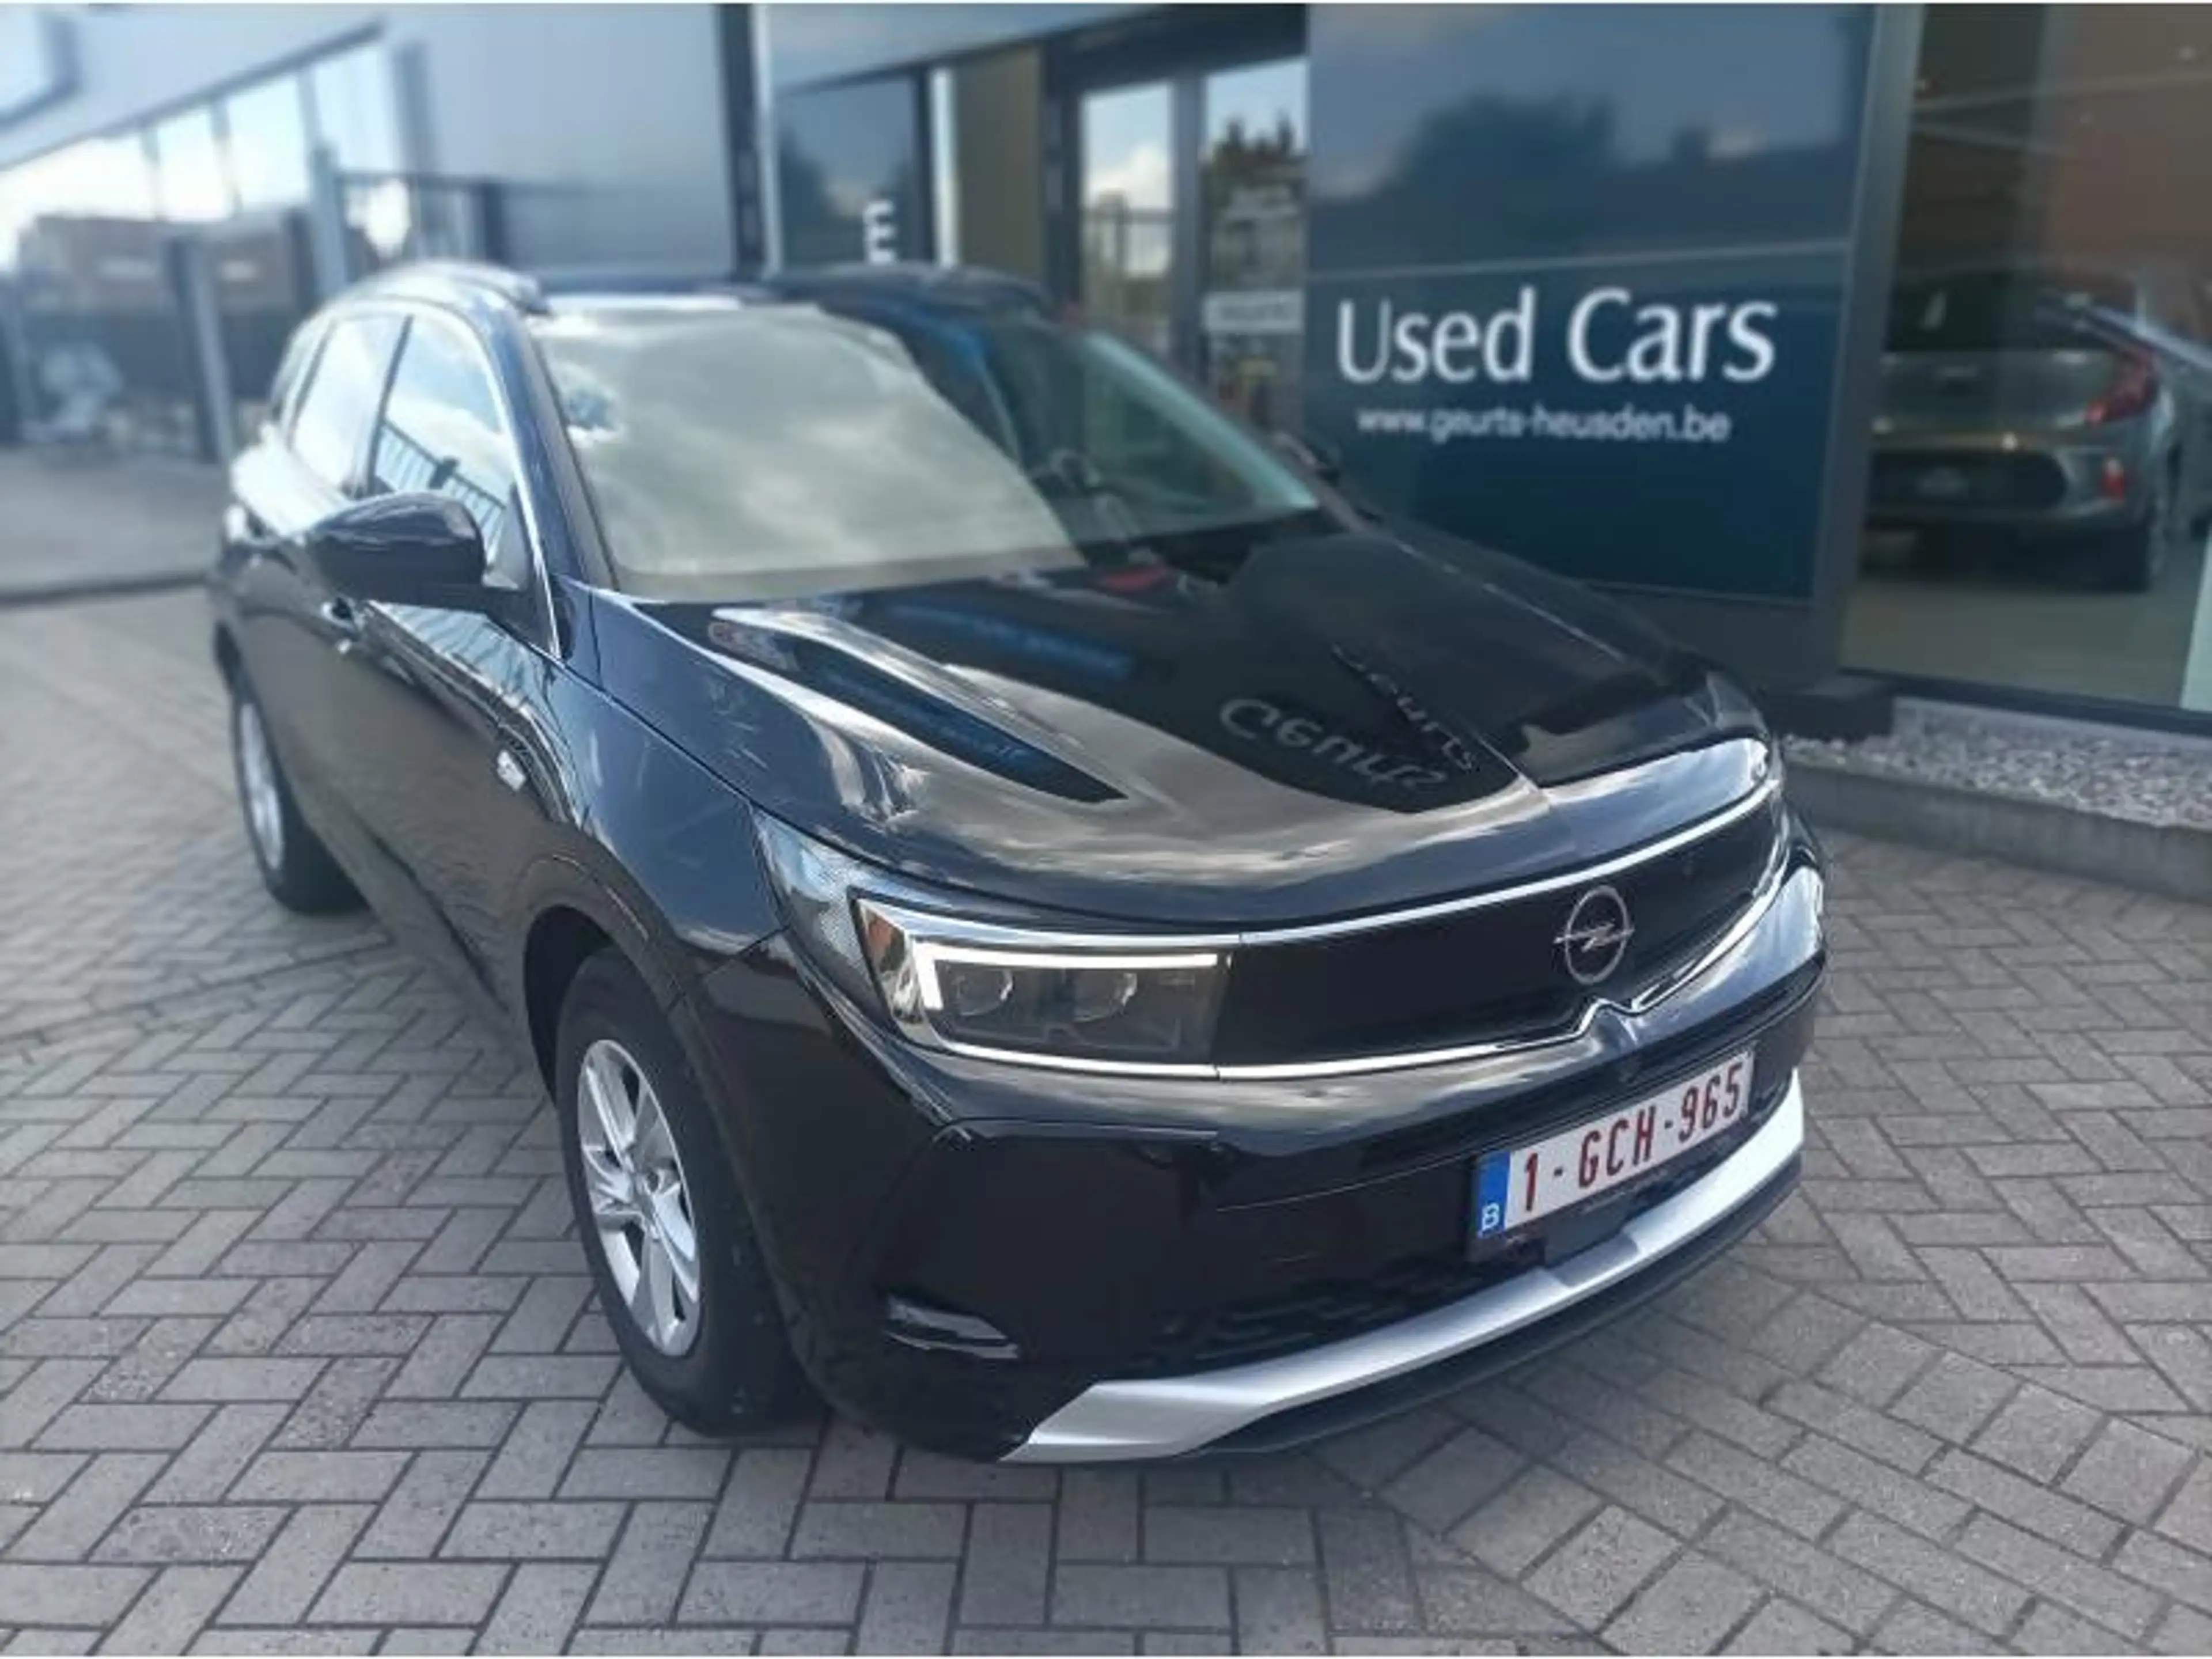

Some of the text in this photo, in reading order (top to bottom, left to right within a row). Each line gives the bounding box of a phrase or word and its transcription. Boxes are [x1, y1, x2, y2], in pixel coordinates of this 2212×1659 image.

[1336, 285, 1778, 384] Used Cars
[1480, 1202, 1499, 1230] B
